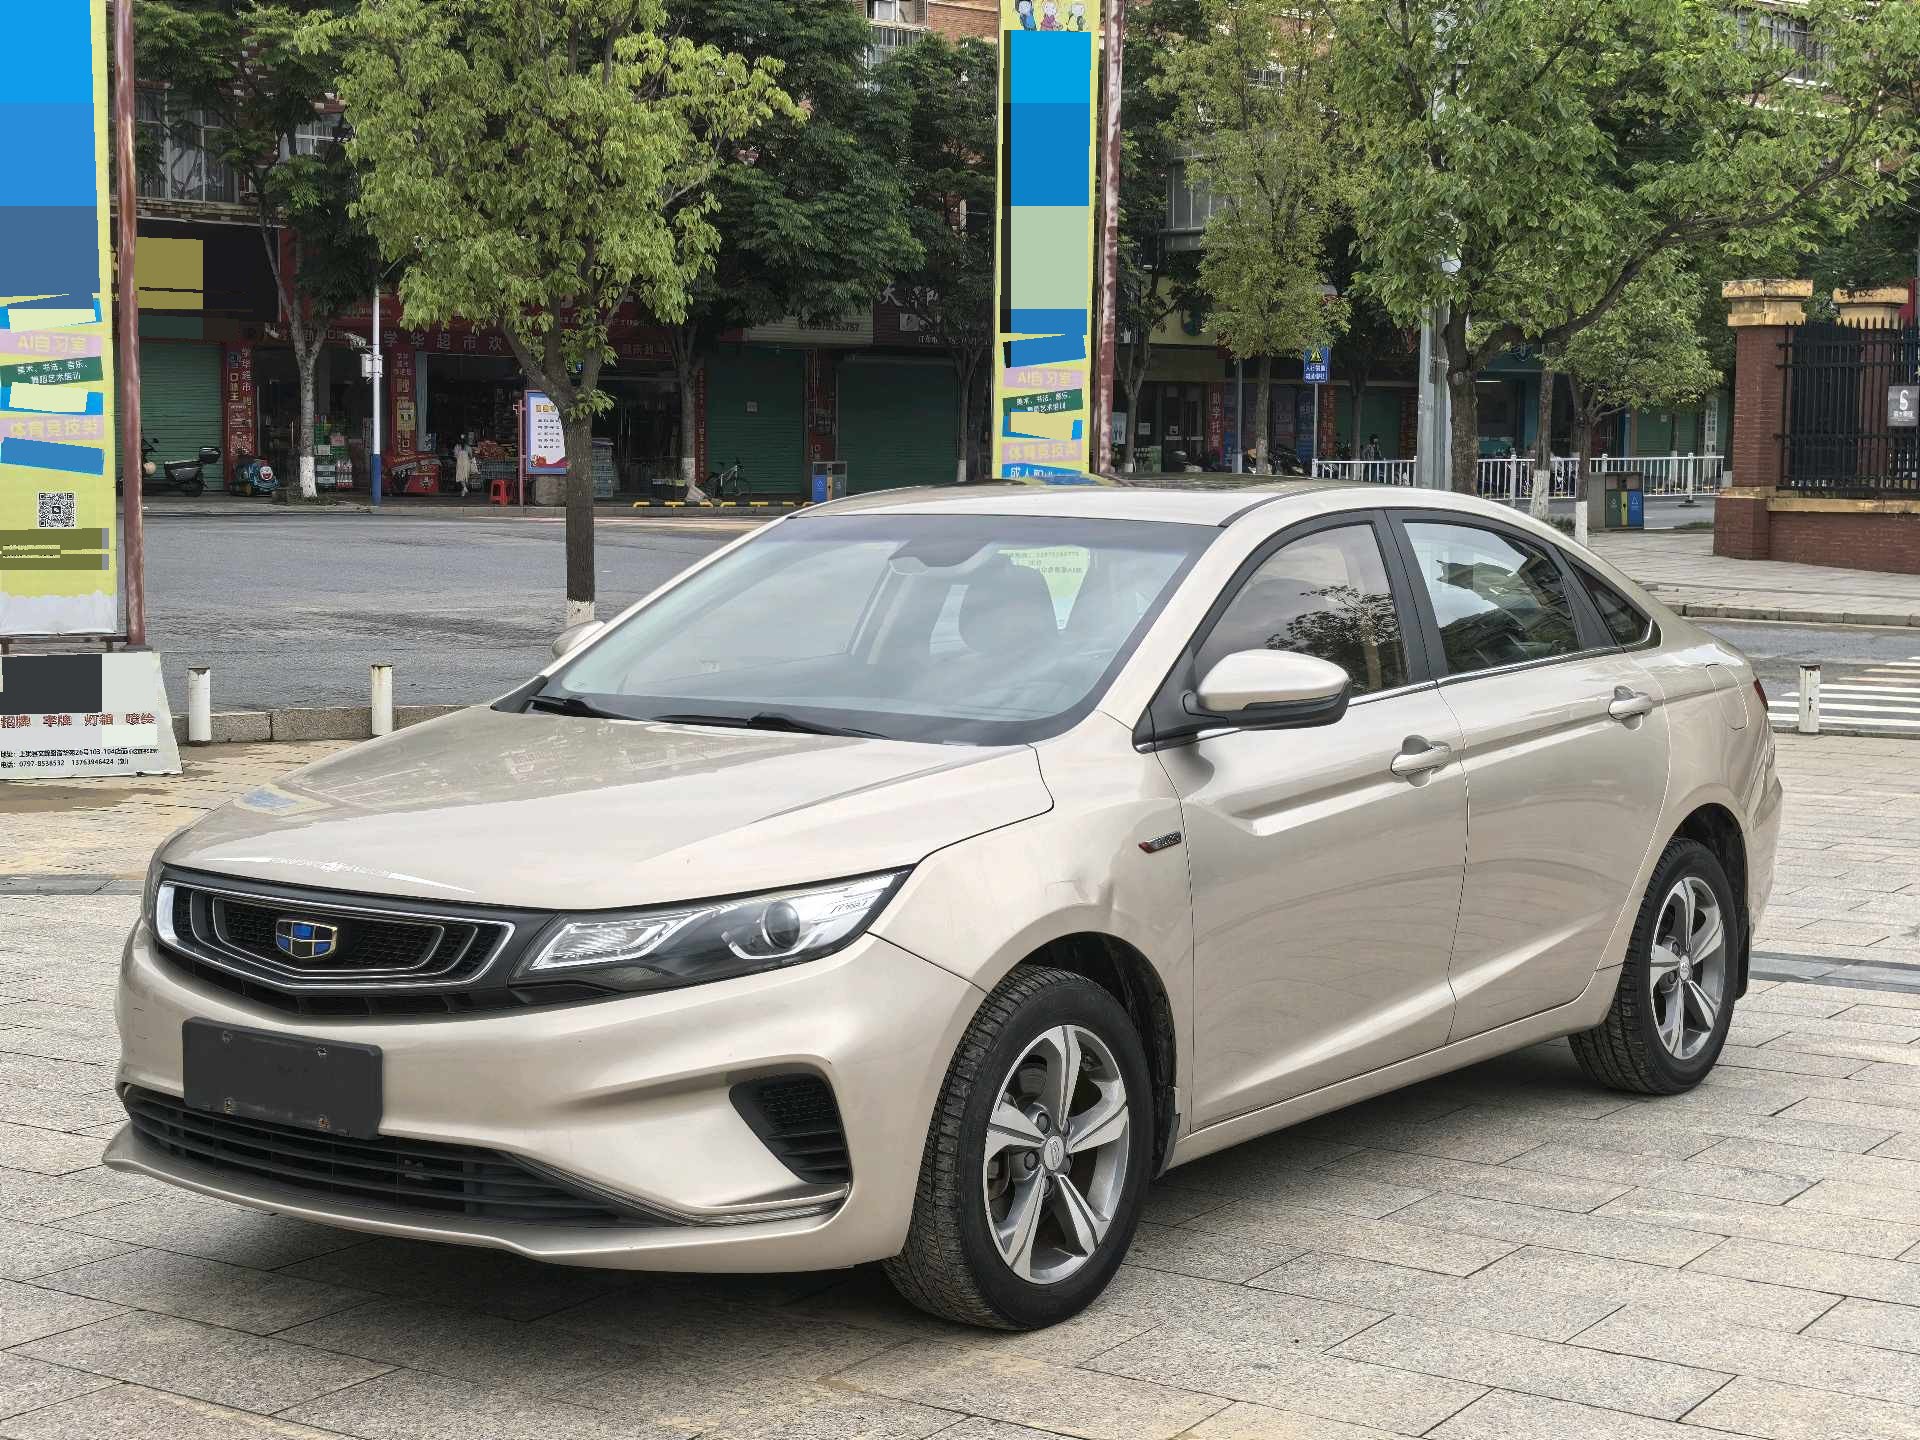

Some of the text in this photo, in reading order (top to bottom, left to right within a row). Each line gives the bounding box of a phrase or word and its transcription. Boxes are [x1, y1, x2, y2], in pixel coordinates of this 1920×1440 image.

[17, 335, 87, 352] AI自习室
[1016, 369, 1073, 386] AI自习室
[84, 713, 114, 726] 灯箱
[126, 712, 156, 725] 喷绘
